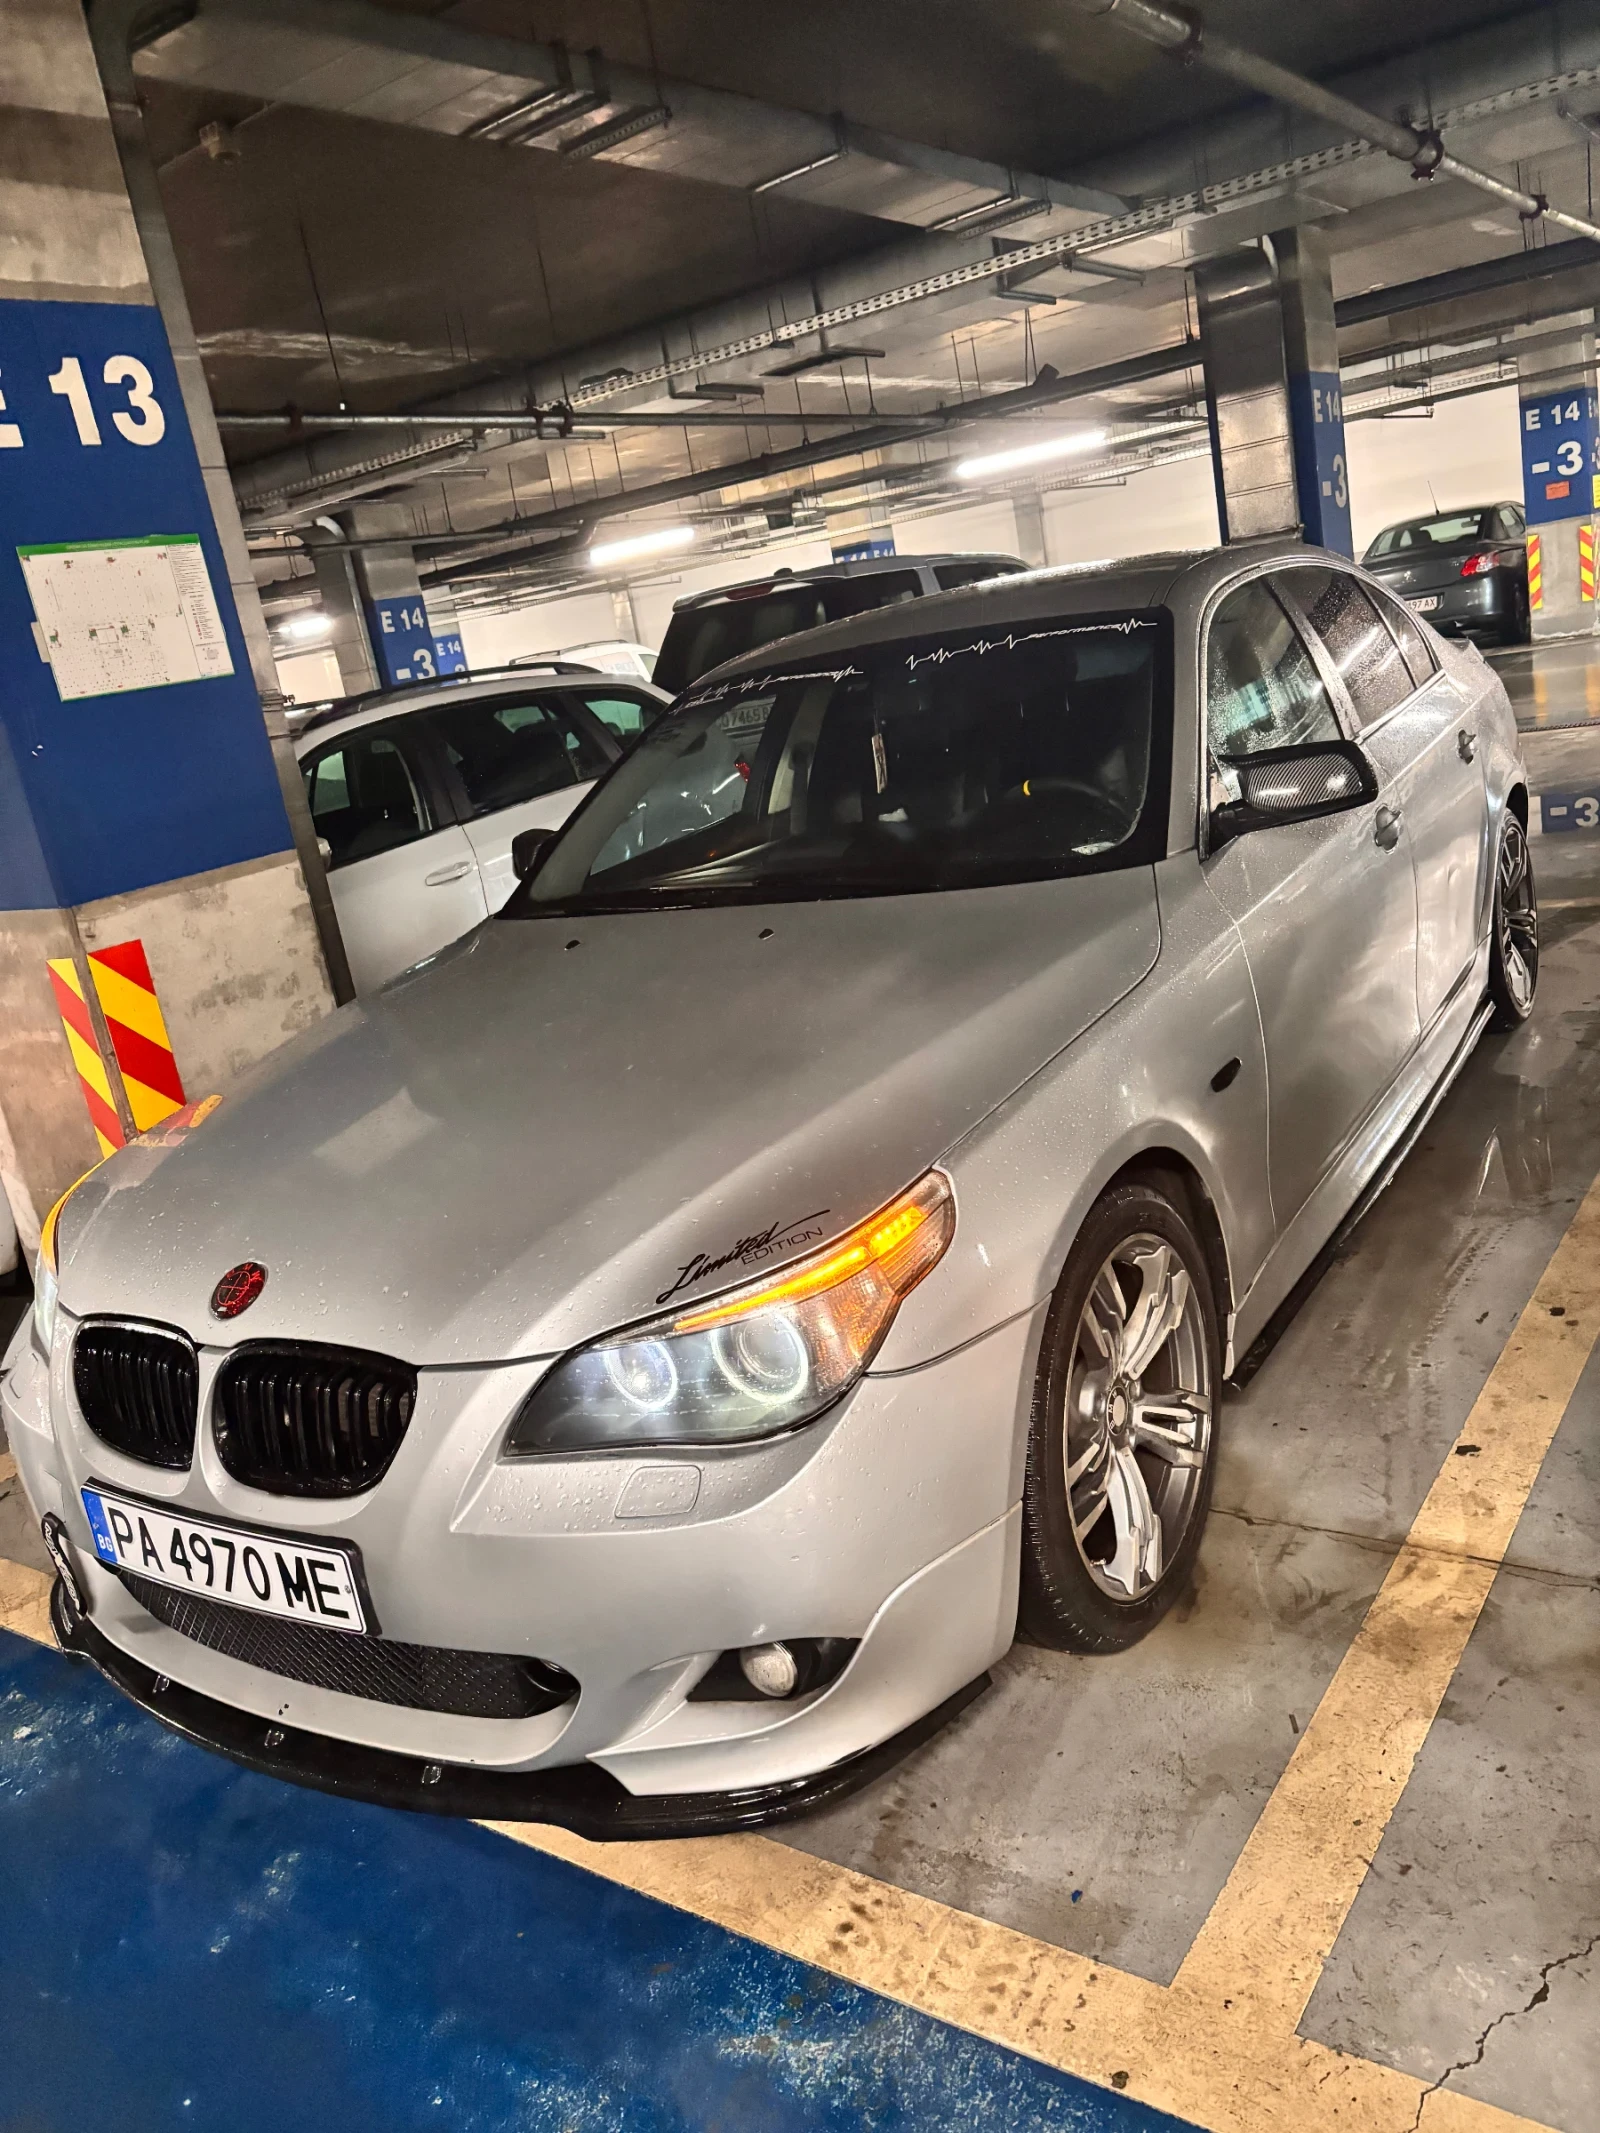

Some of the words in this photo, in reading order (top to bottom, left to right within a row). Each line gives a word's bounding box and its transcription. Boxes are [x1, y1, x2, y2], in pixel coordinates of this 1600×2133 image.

[48, 355, 165, 446] 13
[1313, 389, 1323, 422] E
[1326, 391, 1341, 422] 14
[1525, 408, 1541, 430] E
[1551, 401, 1580, 425] 14
[1424, 598, 1436, 608] AX
[381, 611, 395, 633] E
[401, 607, 424, 630] 14
[436, 643, 445, 656] E
[448, 641, 460, 654] 14
[656, 1209, 830, 1304] Limited
[741, 1227, 823, 1265] EDITION
[98, 1534, 113, 1552] BG
[108, 1507, 164, 1573] PA
[170, 1527, 270, 1601] 4970
[275, 1552, 350, 1619] ME
